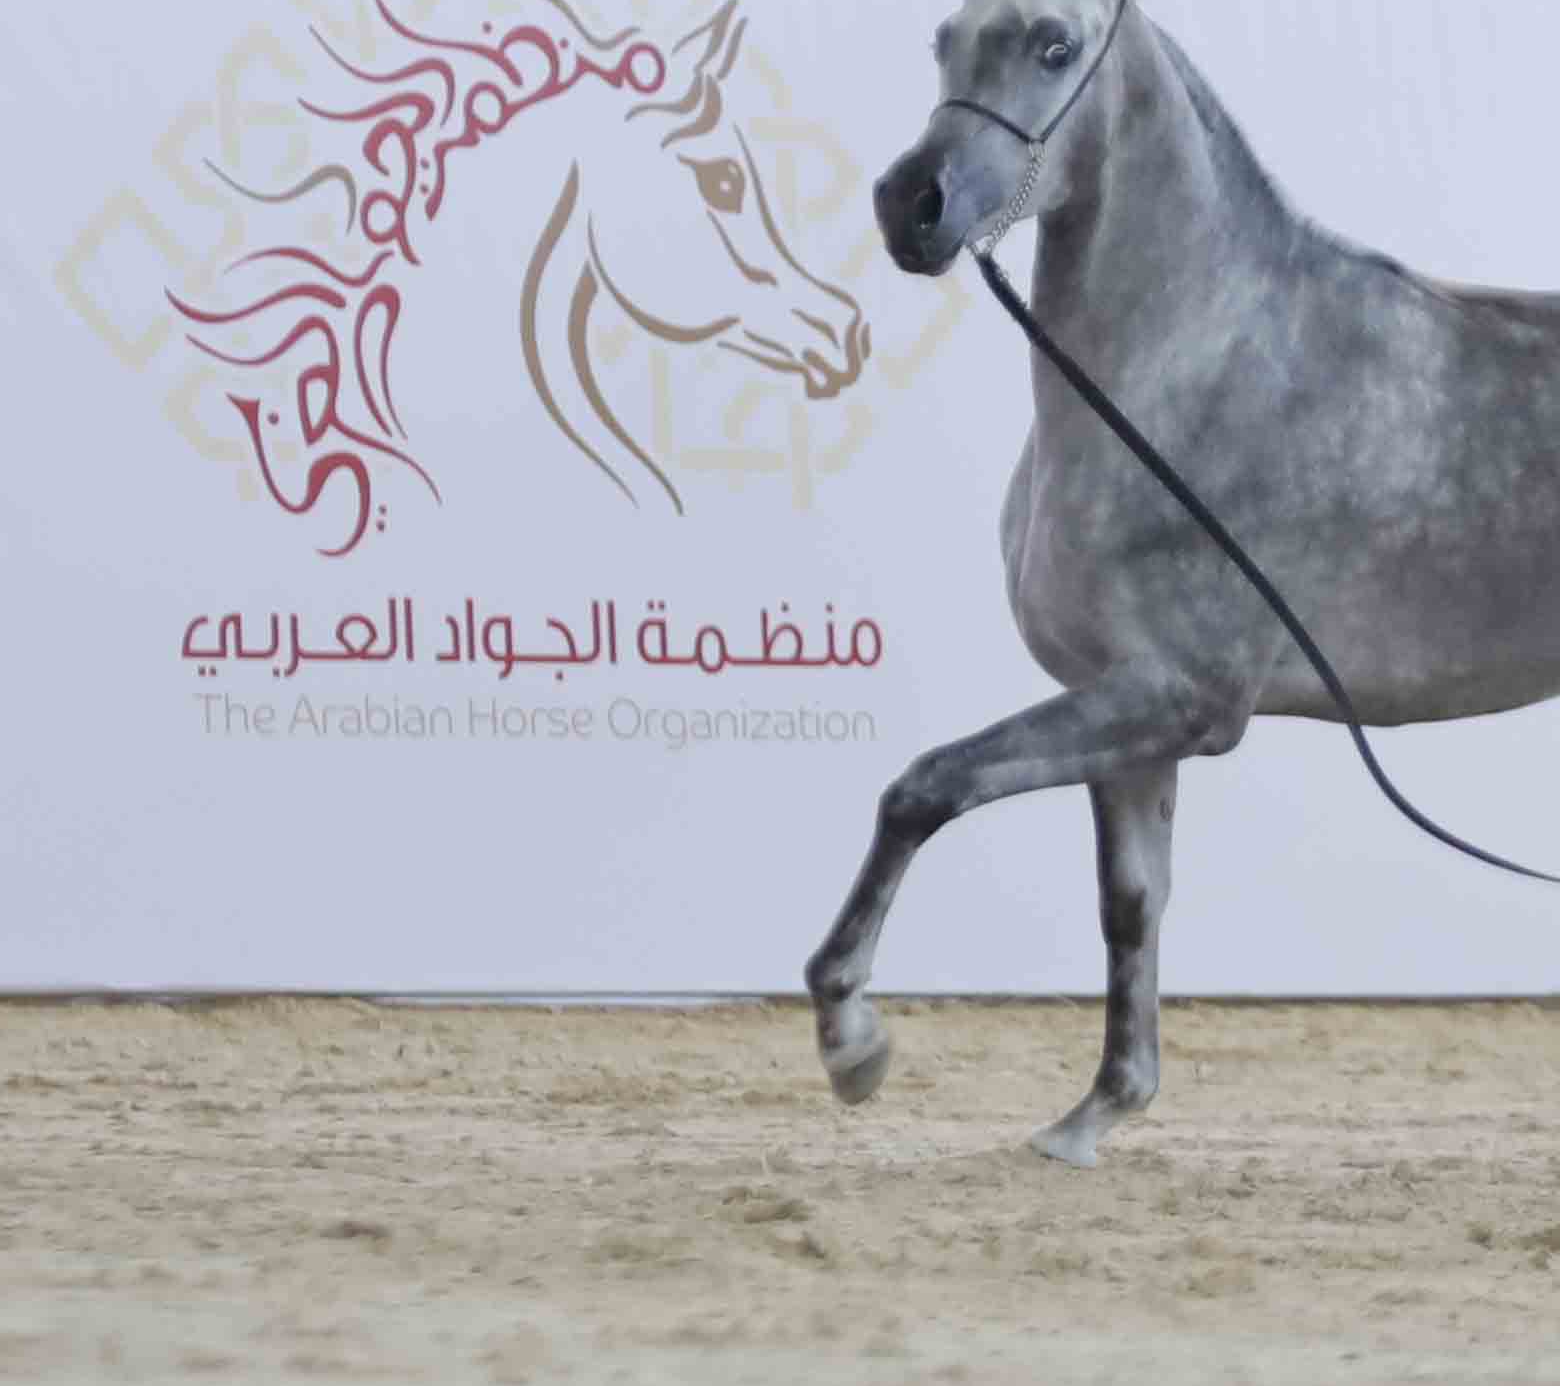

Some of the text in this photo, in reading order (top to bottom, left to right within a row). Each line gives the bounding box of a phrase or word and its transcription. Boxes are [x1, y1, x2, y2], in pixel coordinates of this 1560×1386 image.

[181, 594, 883, 682] منظمة الجواد العربي
[195, 693, 875, 750] The Arabian Horse Organization
